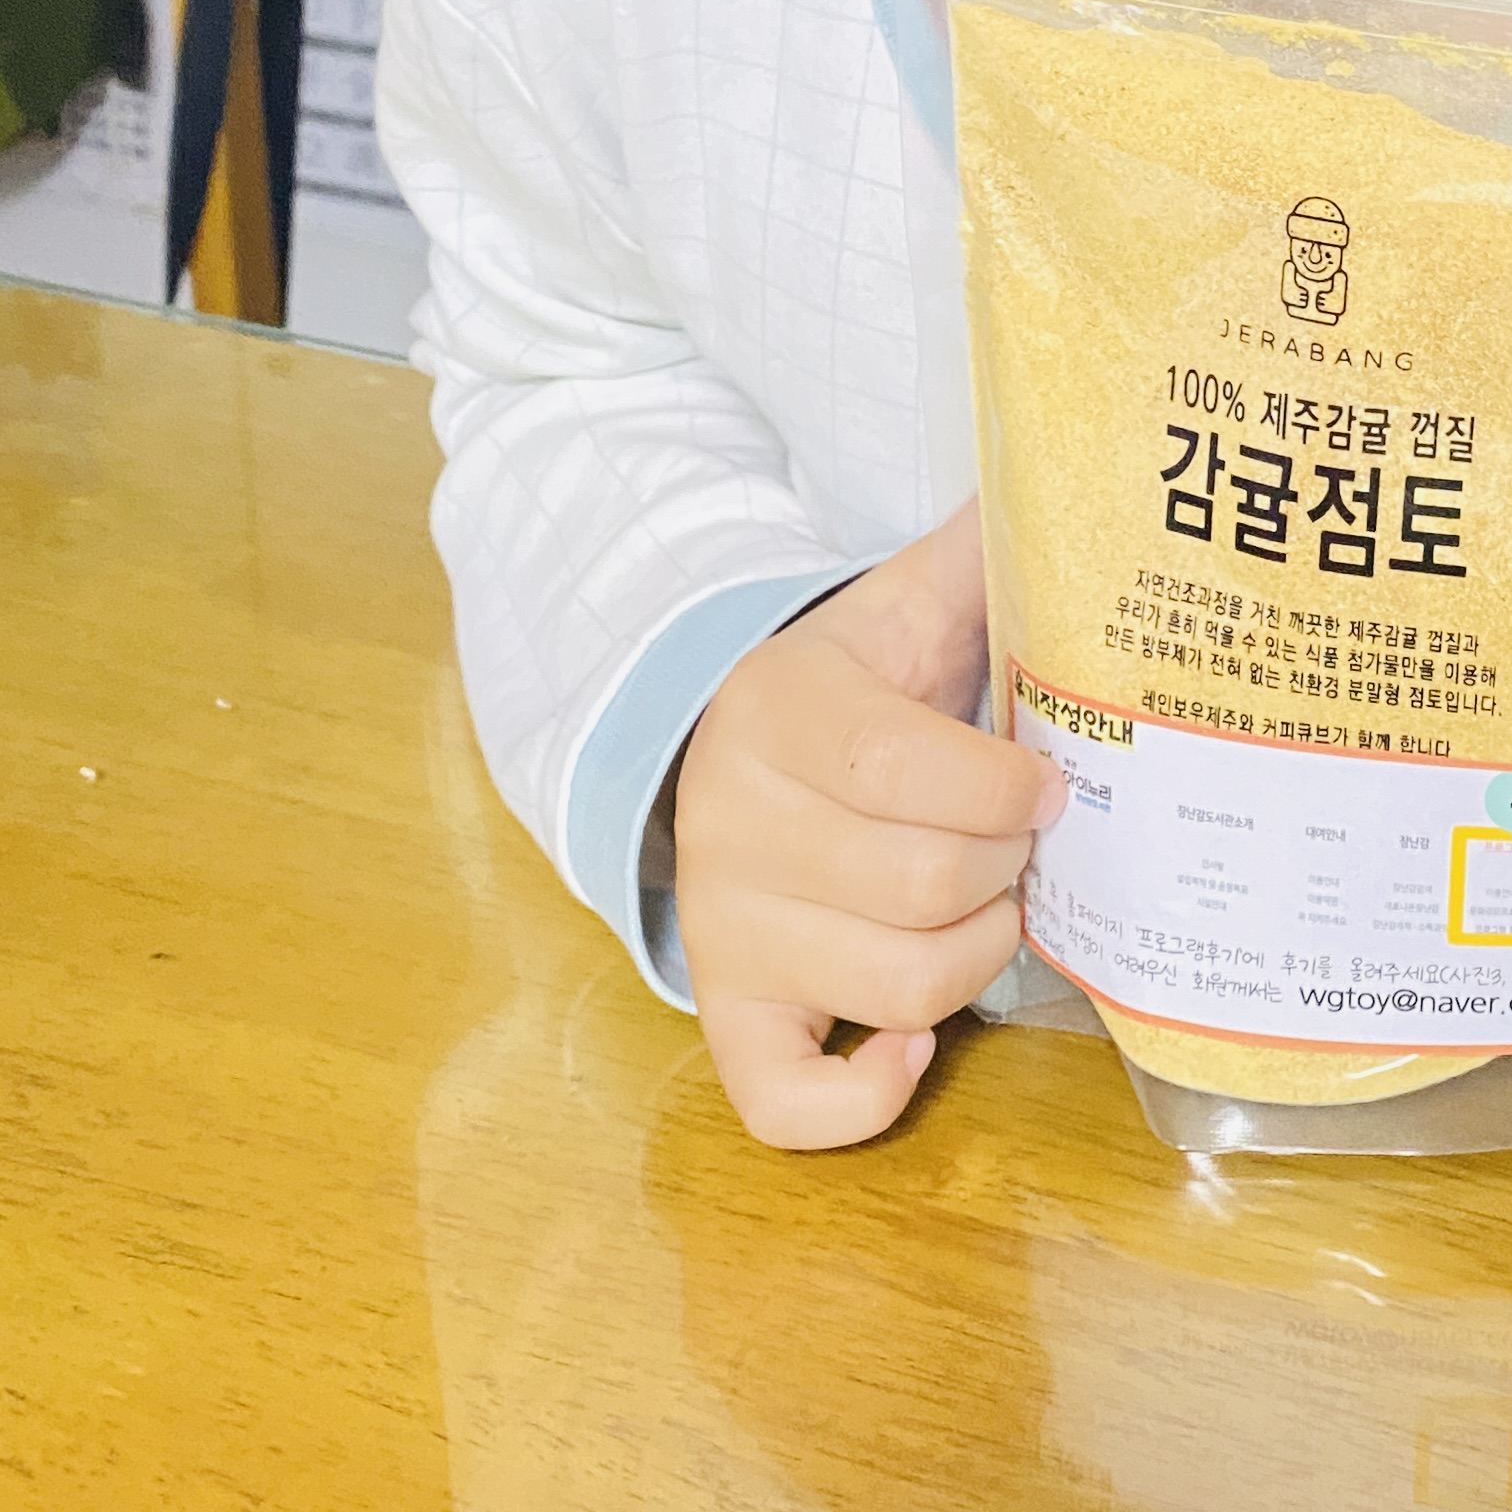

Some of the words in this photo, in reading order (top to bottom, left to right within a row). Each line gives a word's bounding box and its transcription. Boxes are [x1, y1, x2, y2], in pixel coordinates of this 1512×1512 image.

[1220, 319, 1414, 371] JERABANG
[1166, 365, 1246, 422] 100%
[1260, 390, 1392, 456] 제주감귤
[1410, 411, 1475, 463] 껍질
[1160, 423, 1468, 579] 감귤점토
[1115, 596, 1161, 630] 우리가
[1167, 609, 1197, 638] 흔히
[1205, 620, 1234, 649] 먹을
[1242, 632, 1257, 654] 수
[1265, 636, 1297, 663] 있는
[1305, 644, 1339, 669] 식품
[1347, 650, 1435, 681] 첨가물만을
[1445, 662, 1497, 688] 이용해
[1135, 569, 1243, 620] 자연건조과정을
[1250, 600, 1281, 630] 거친
[1288, 611, 1340, 639] 깨끗한
[1348, 620, 1418, 649] 제주감귤
[1428, 630, 1479, 657] 껍질과
[1105, 624, 1135, 653] 만든
[1142, 634, 1202, 670] 방부제가
[1210, 653, 1241, 681] 전혀
[1250, 662, 1281, 689] 없는
[1289, 670, 1339, 698] 친환경
[1349, 679, 1400, 707] 분말형
[1408, 686, 1502, 717] 점토입니다.
[1141, 689, 1254, 735] 레인보우제주와
[1262, 718, 1348, 747] 커피큐브가
[1358, 729, 1390, 751] 함께
[1177, 804, 1254, 831] 장난감도서관소개
[1305, 825, 1346, 842] 대여안내
[1399, 834, 1430, 851] 장난감
[1114, 952, 1178, 987] 어려우신
[1192, 970, 1282, 1003] 회원께서는
[1280, 951, 1332, 980] 후기를
